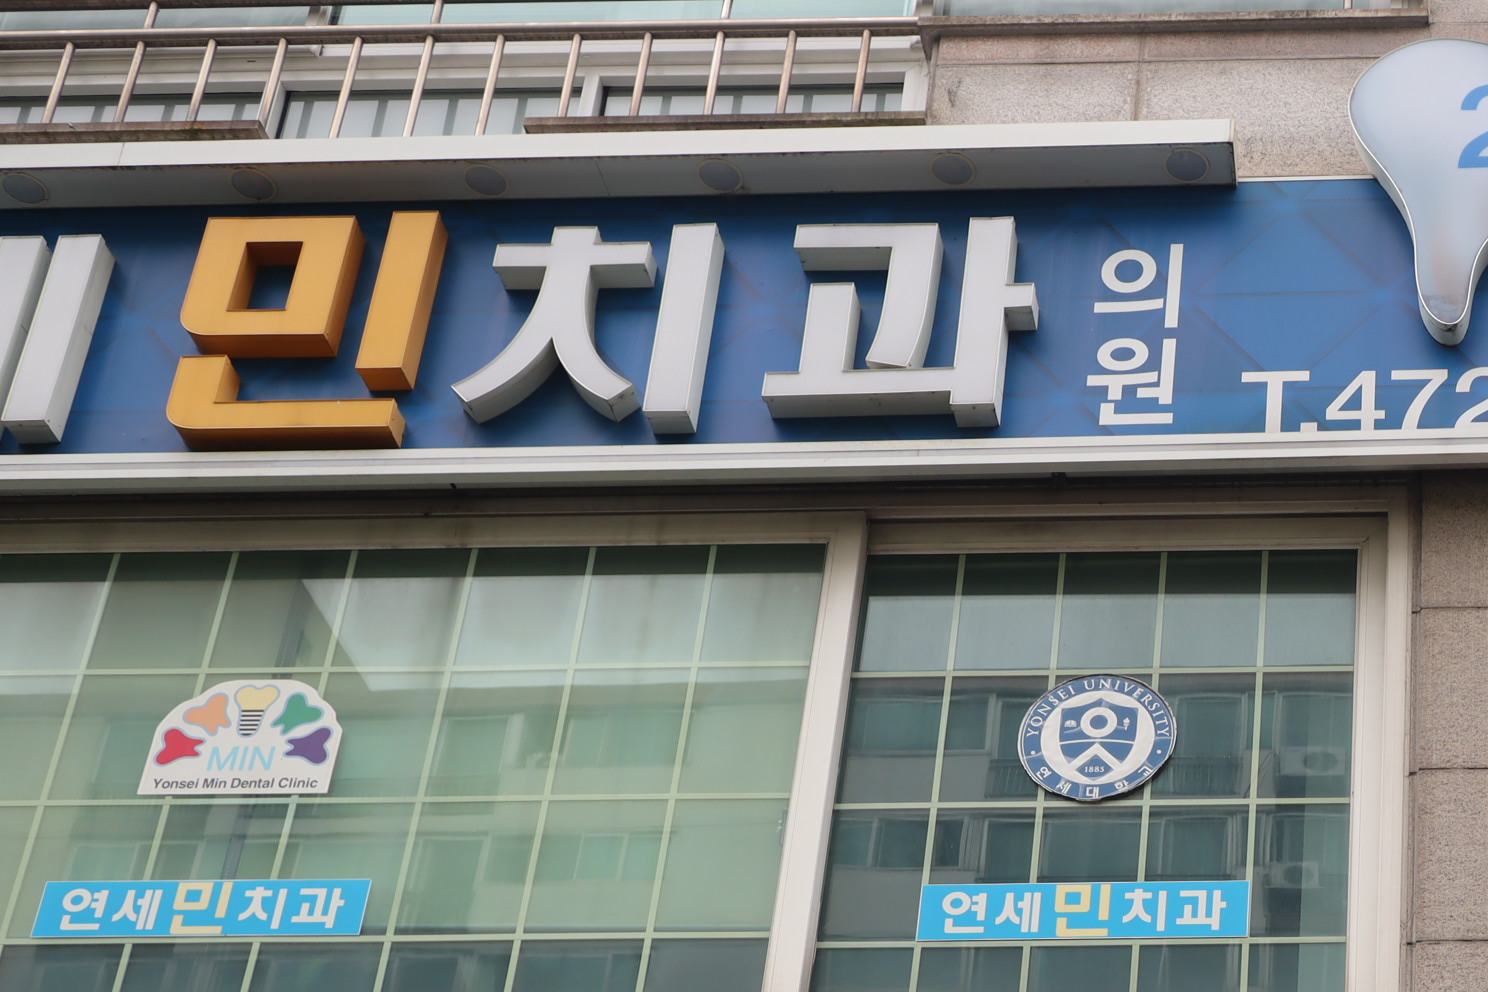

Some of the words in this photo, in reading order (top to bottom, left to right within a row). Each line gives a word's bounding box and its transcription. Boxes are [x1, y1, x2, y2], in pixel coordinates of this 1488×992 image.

[1026, 685, 1076, 737] YONSEI
[1083, 678, 1170, 737] UNIVERSITY
[206, 746, 276, 771] MIN
[1084, 765, 1105, 773] 1885
[153, 778, 199, 789] Yonsei
[202, 778, 227, 789] Min
[230, 778, 275, 789] Dental
[278, 777, 318, 789] Clinic
[59, 881, 346, 934] 연세민치과
[941, 884, 1227, 937] 연세민치과
